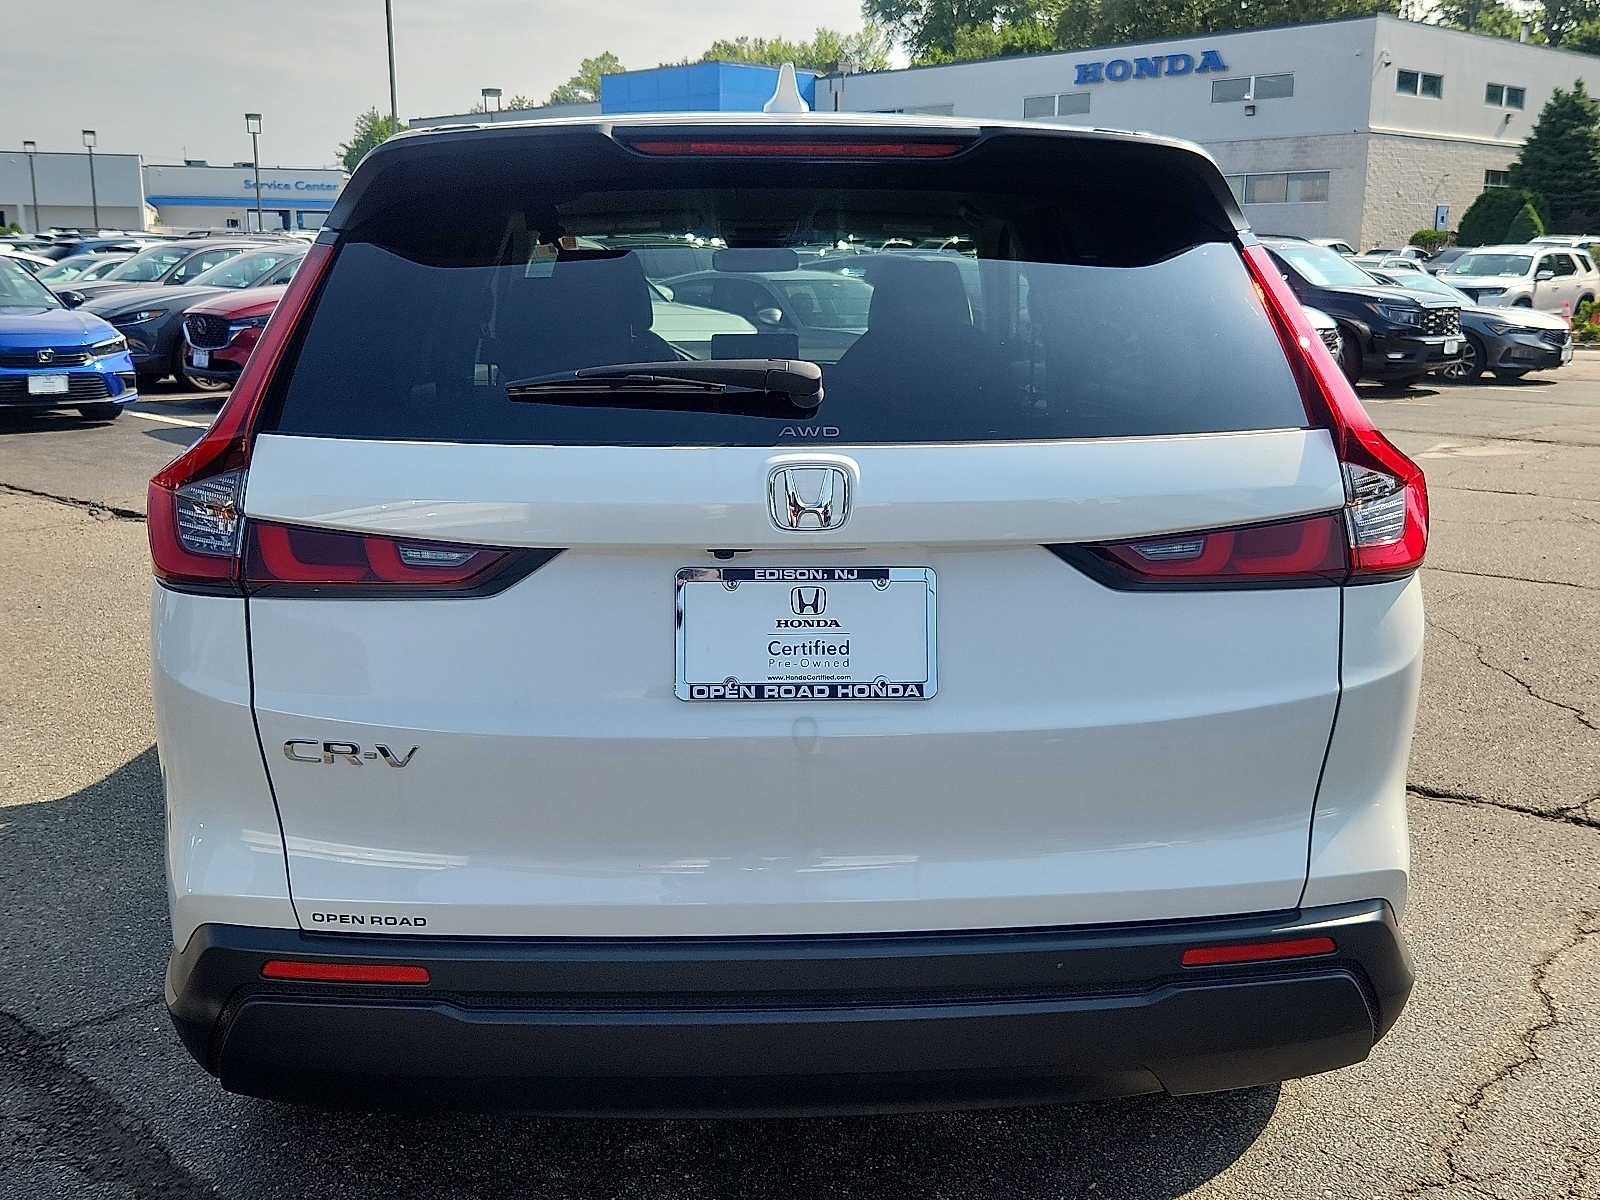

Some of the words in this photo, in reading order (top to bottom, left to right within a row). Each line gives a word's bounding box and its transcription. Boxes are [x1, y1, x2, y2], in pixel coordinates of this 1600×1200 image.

[1074, 50, 1229, 84] HONDA
[294, 181, 339, 191] Center
[778, 426, 840, 437] AWD
[754, 569, 828, 580] EDISON,
[834, 569, 858, 580] NJ
[775, 619, 842, 629] HONDA
[767, 639, 850, 656] Certified
[768, 658, 850, 668] Pre-Owned
[692, 685, 756, 699] OPEN
[763, 685, 830, 698] ROAD
[837, 684, 921, 698] HONDA
[283, 738, 420, 768] CR-V
[311, 912, 365, 925] OPEN
[370, 915, 427, 927] ROAD
